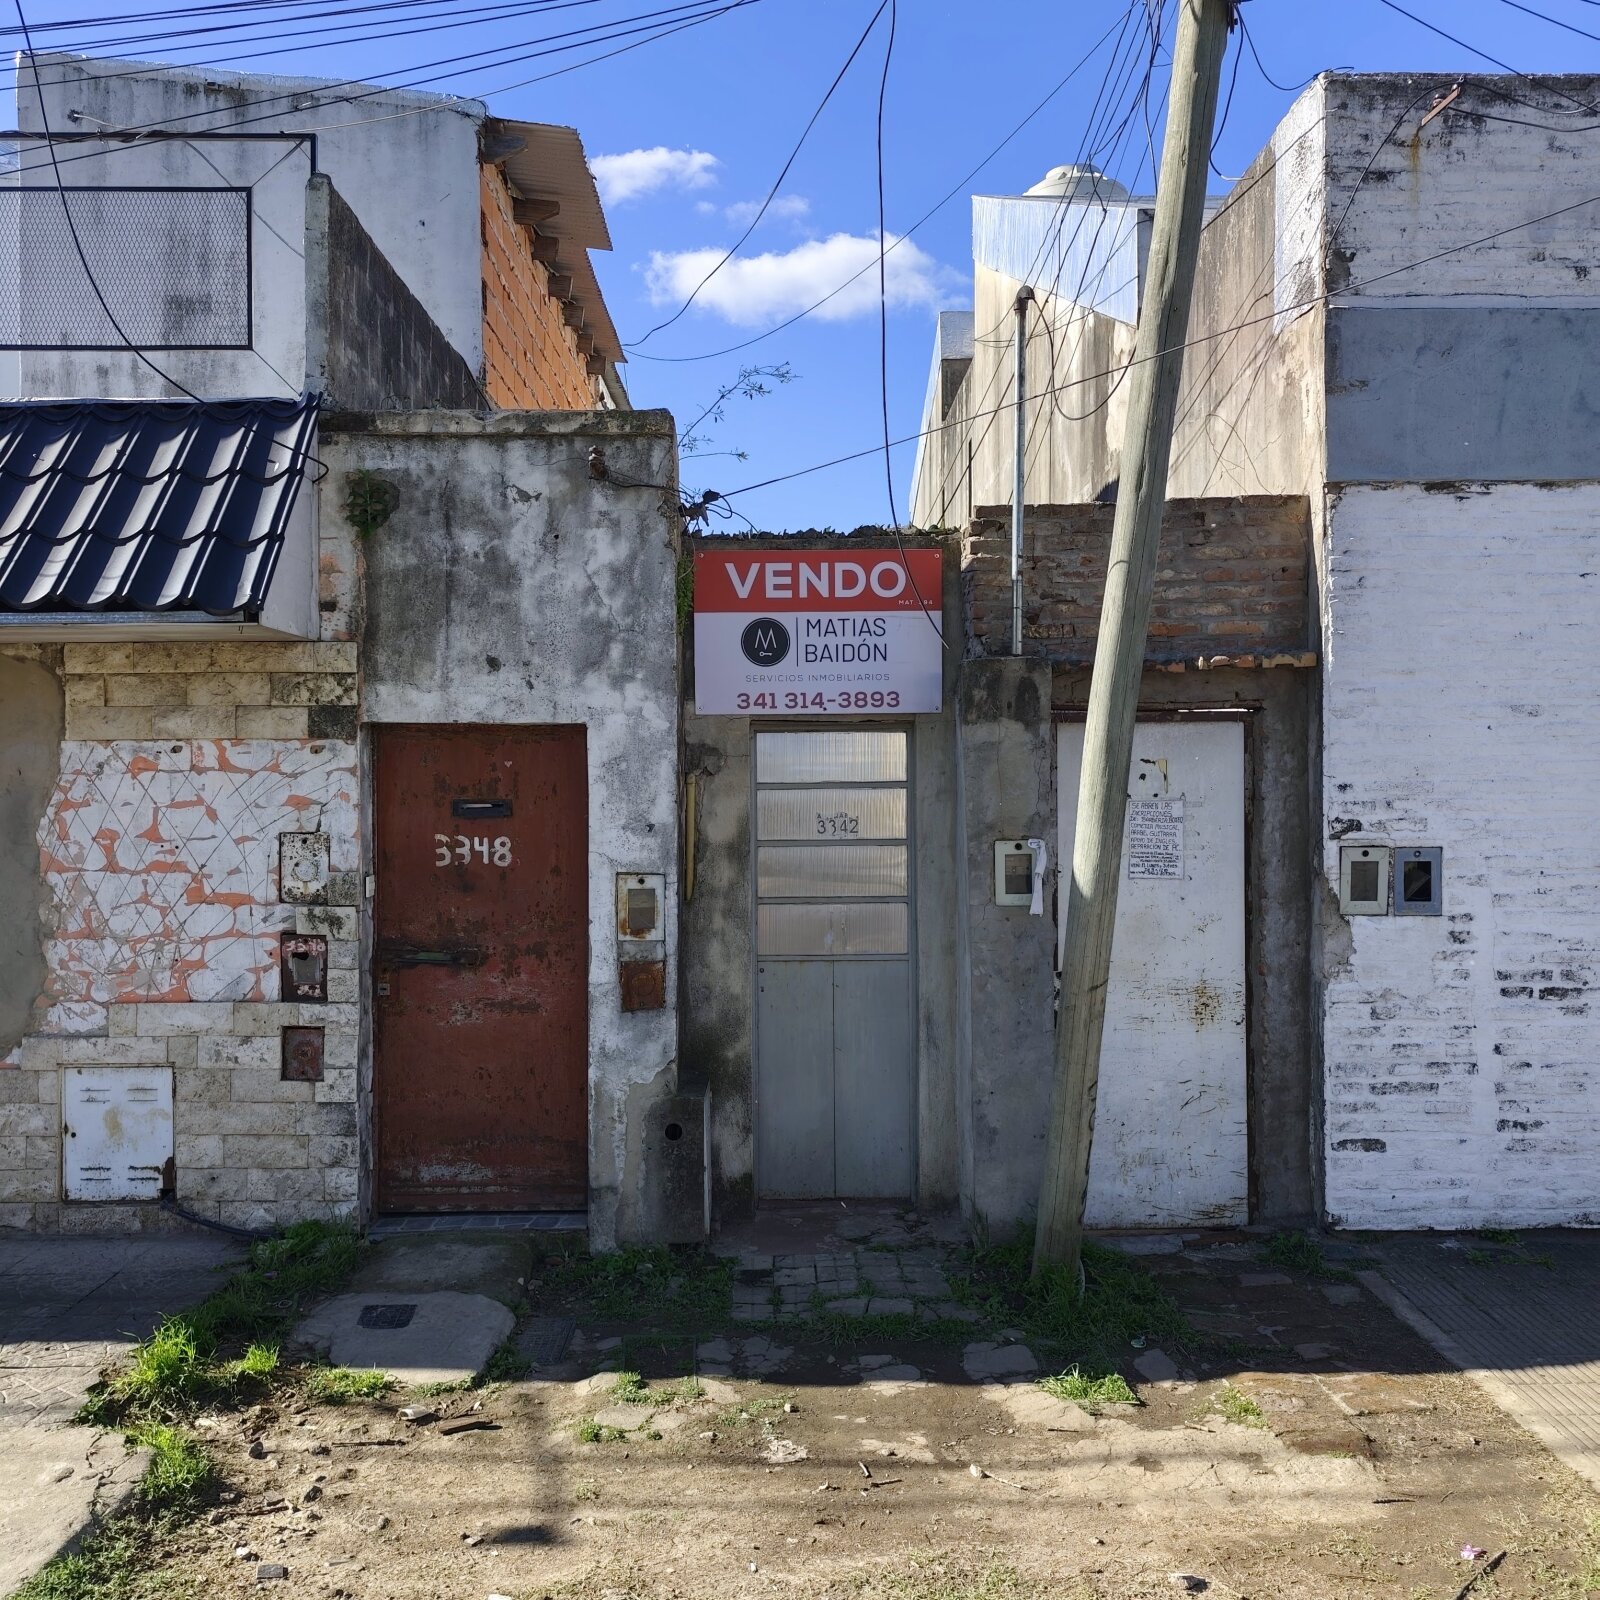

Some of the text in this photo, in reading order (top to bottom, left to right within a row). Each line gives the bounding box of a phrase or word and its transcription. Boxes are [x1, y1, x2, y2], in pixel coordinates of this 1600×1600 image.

[724, 561, 907, 599] VENDO
[806, 617, 886, 637] MATIAS
[805, 639, 887, 663] BAIDÓN
[745, 673, 890, 683] SERVICIOS INMOBILIARIOS
[736, 691, 900, 709] 341 314-3893
[817, 819, 859, 836] 3342
[434, 833, 512, 867] 3348
